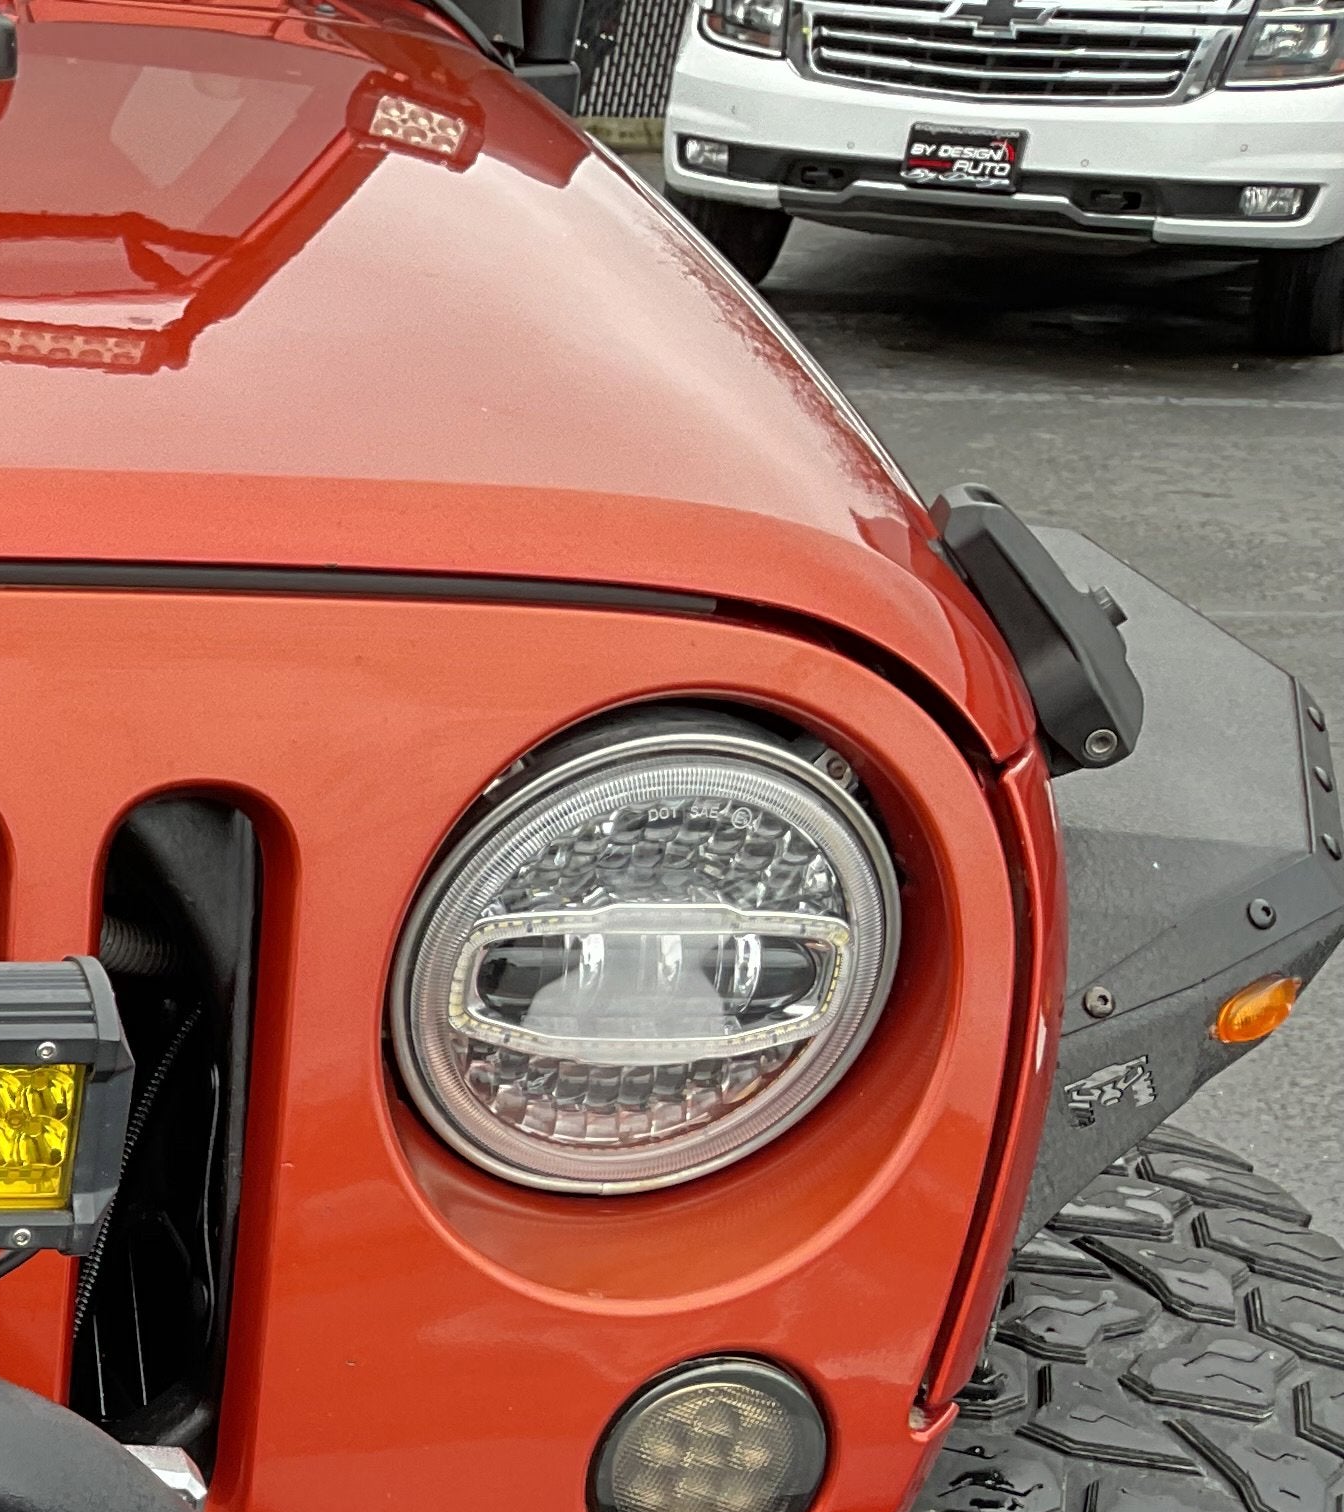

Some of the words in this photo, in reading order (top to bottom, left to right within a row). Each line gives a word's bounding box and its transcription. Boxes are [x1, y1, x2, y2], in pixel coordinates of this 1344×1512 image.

[910, 143, 937, 157] BY
[938, 145, 1004, 161] DESIGN
[953, 160, 1011, 177] AUTO
[648, 806, 679, 822] DOT
[690, 805, 720, 819] SAE
